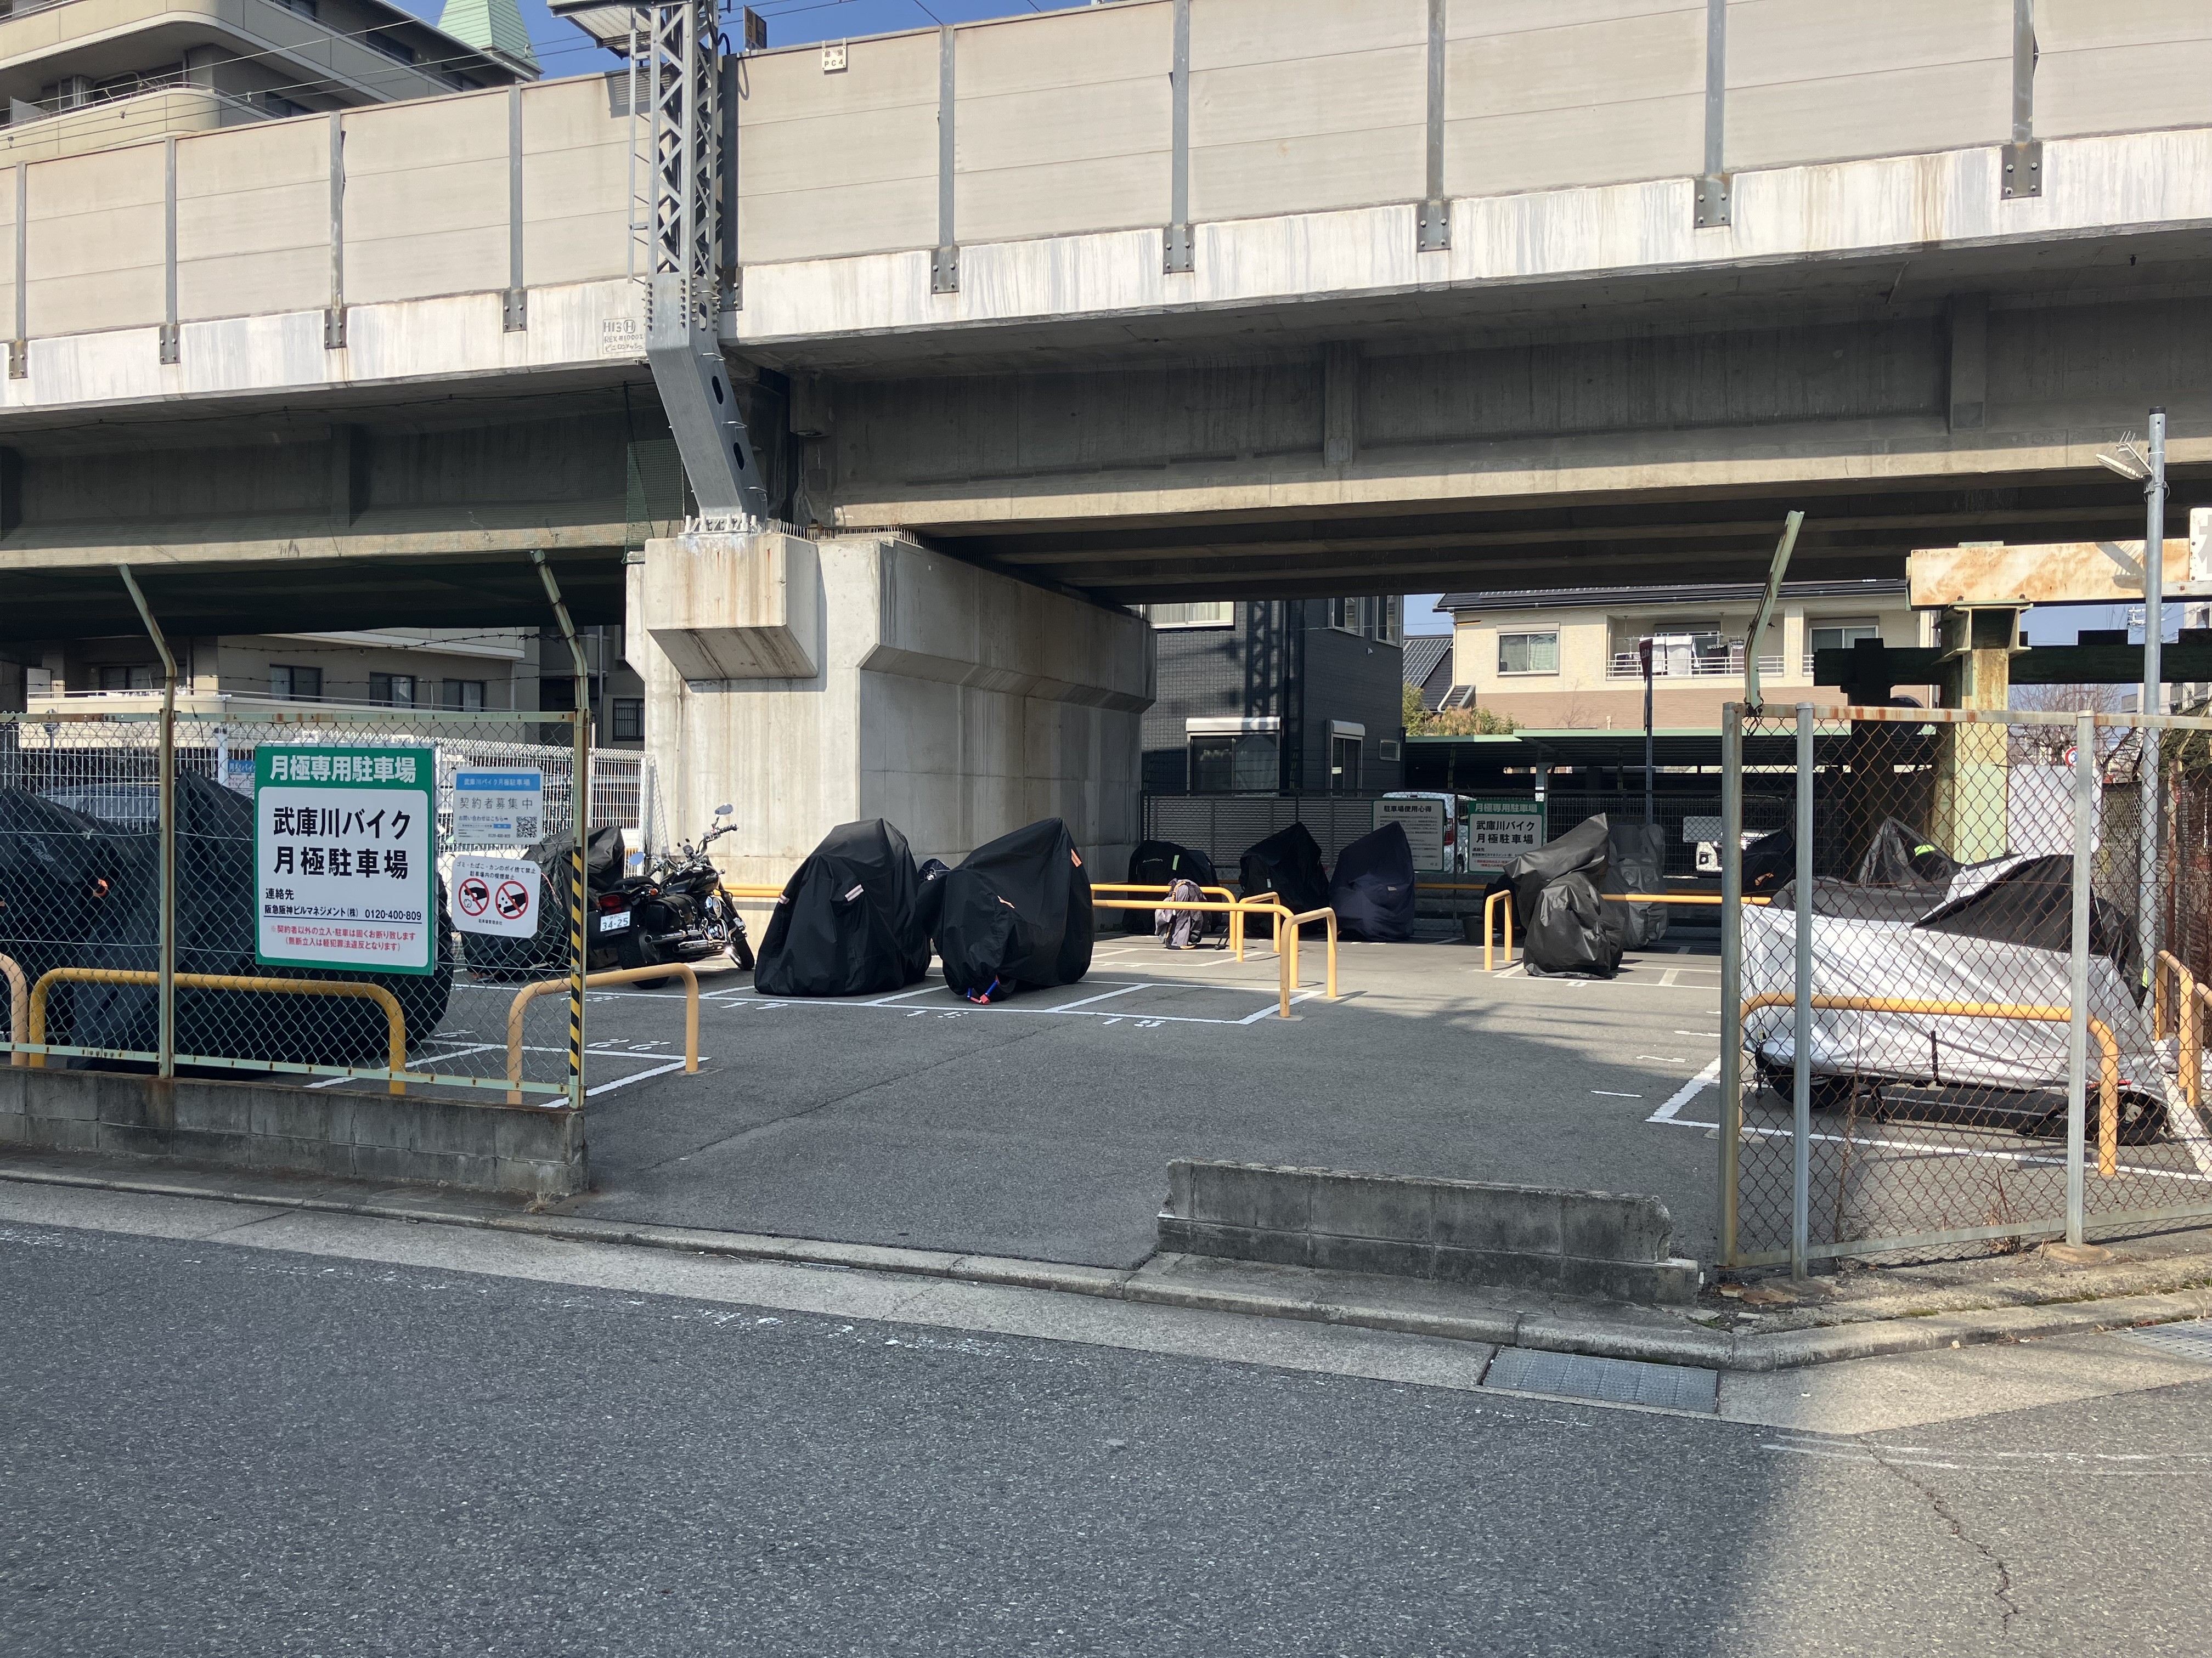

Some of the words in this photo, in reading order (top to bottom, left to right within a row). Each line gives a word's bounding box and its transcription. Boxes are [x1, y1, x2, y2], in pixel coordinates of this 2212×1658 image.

[270, 755, 416, 784] 月極専用駐車場
[464, 778, 531, 786] 武庫川バイク月極駐車場
[460, 797, 533, 810] 契約者募集中
[1475, 803, 1537, 813] 月極専用駐車場
[273, 805, 412, 840] 武庫川バイク
[1476, 820, 1535, 831] 武庫川バイク
[1476, 833, 1534, 845] 月極駐車場
[273, 846, 409, 880] 月極駐車場
[456, 861, 536, 874] ゴミ・たばこ・カンのポイ捨て禁止
[470, 870, 515, 880] 駐車場内の喫煙禁止
[266, 887, 295, 901] 連絡先
[264, 904, 358, 918] 阪急阪神ビルマネジメント(株)
[365, 909, 422, 921] 0120-400-809
[602, 917, 629, 931] 34-25
[285, 937, 401, 952] (無断立入は軽犯罪法違反となります)
